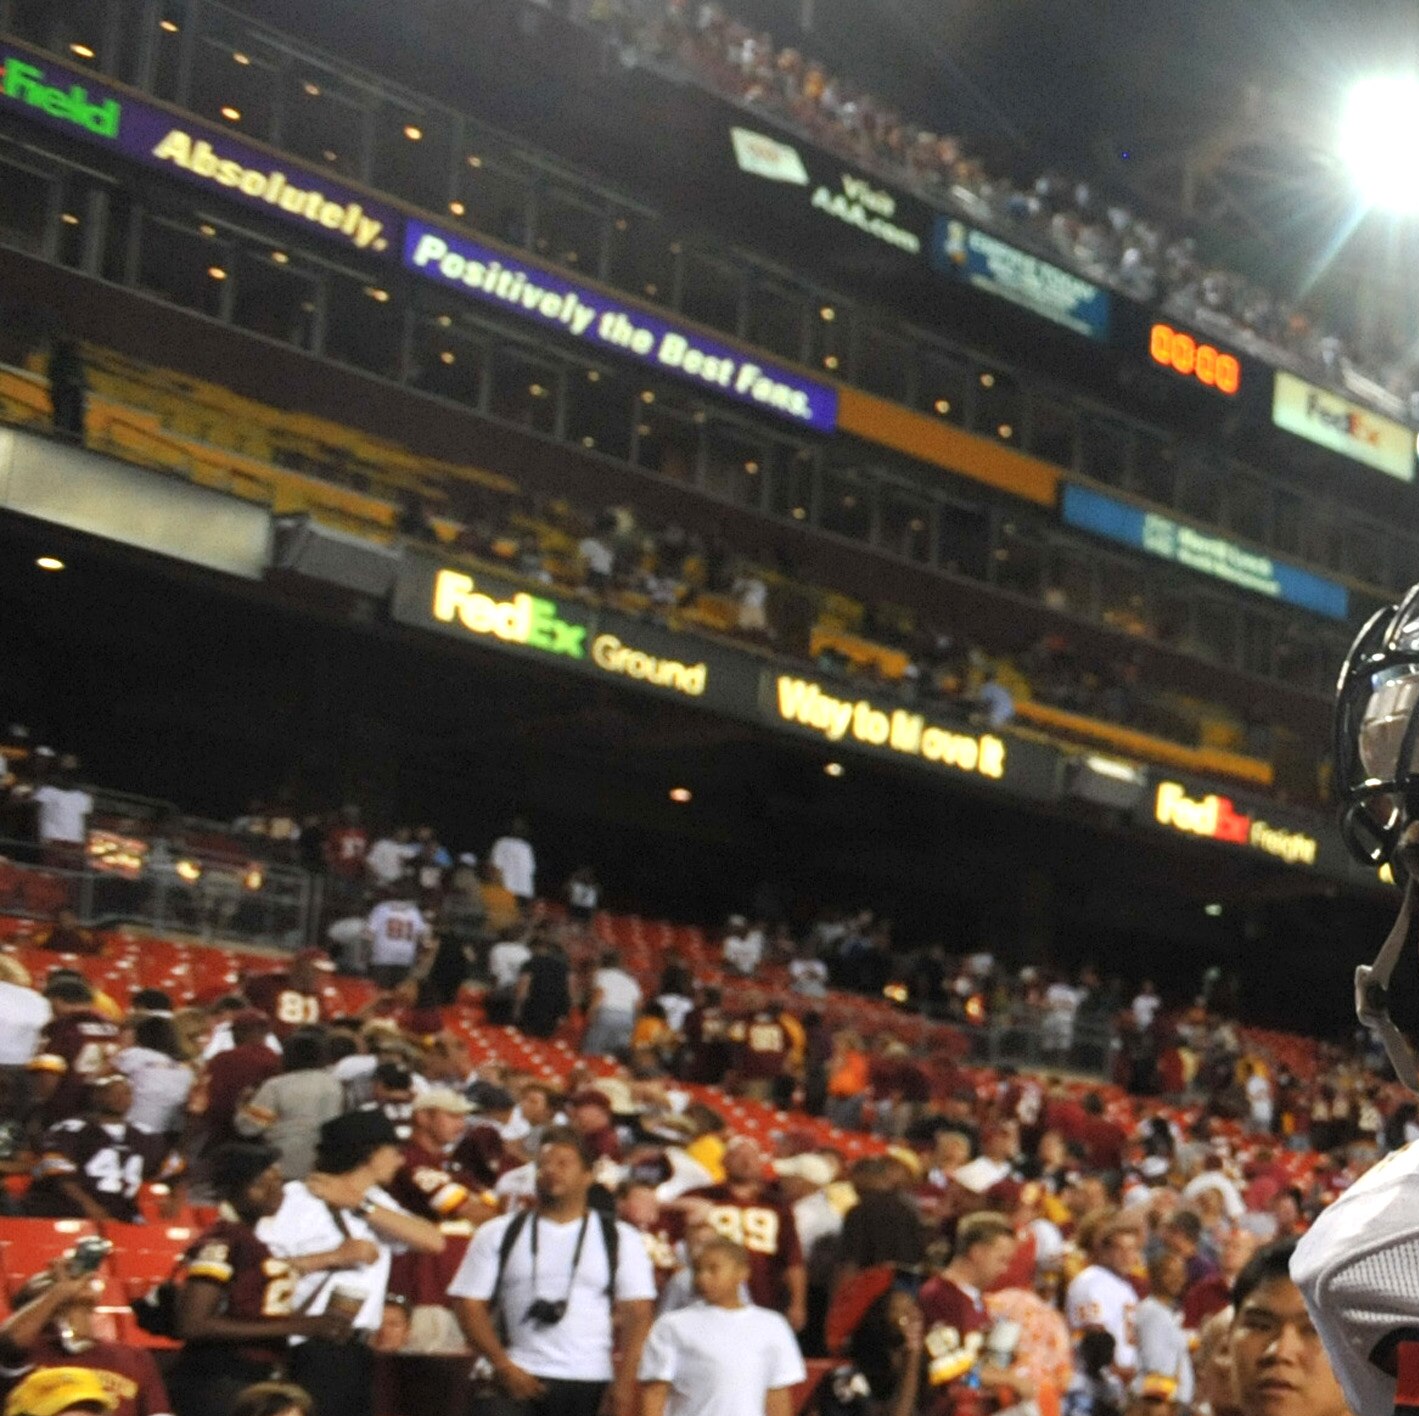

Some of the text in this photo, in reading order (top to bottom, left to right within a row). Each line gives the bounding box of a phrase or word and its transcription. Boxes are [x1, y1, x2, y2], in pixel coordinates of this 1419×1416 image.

[3, 57, 122, 139] Field
[152, 128, 389, 252] Absolutely.
[412, 233, 813, 421] Positively the Best Fans.
[433, 568, 708, 697] FedEx Ground
[777, 674, 854, 743] Way
[852, 700, 891, 746] to
[1156, 781, 1252, 846] FedEx
